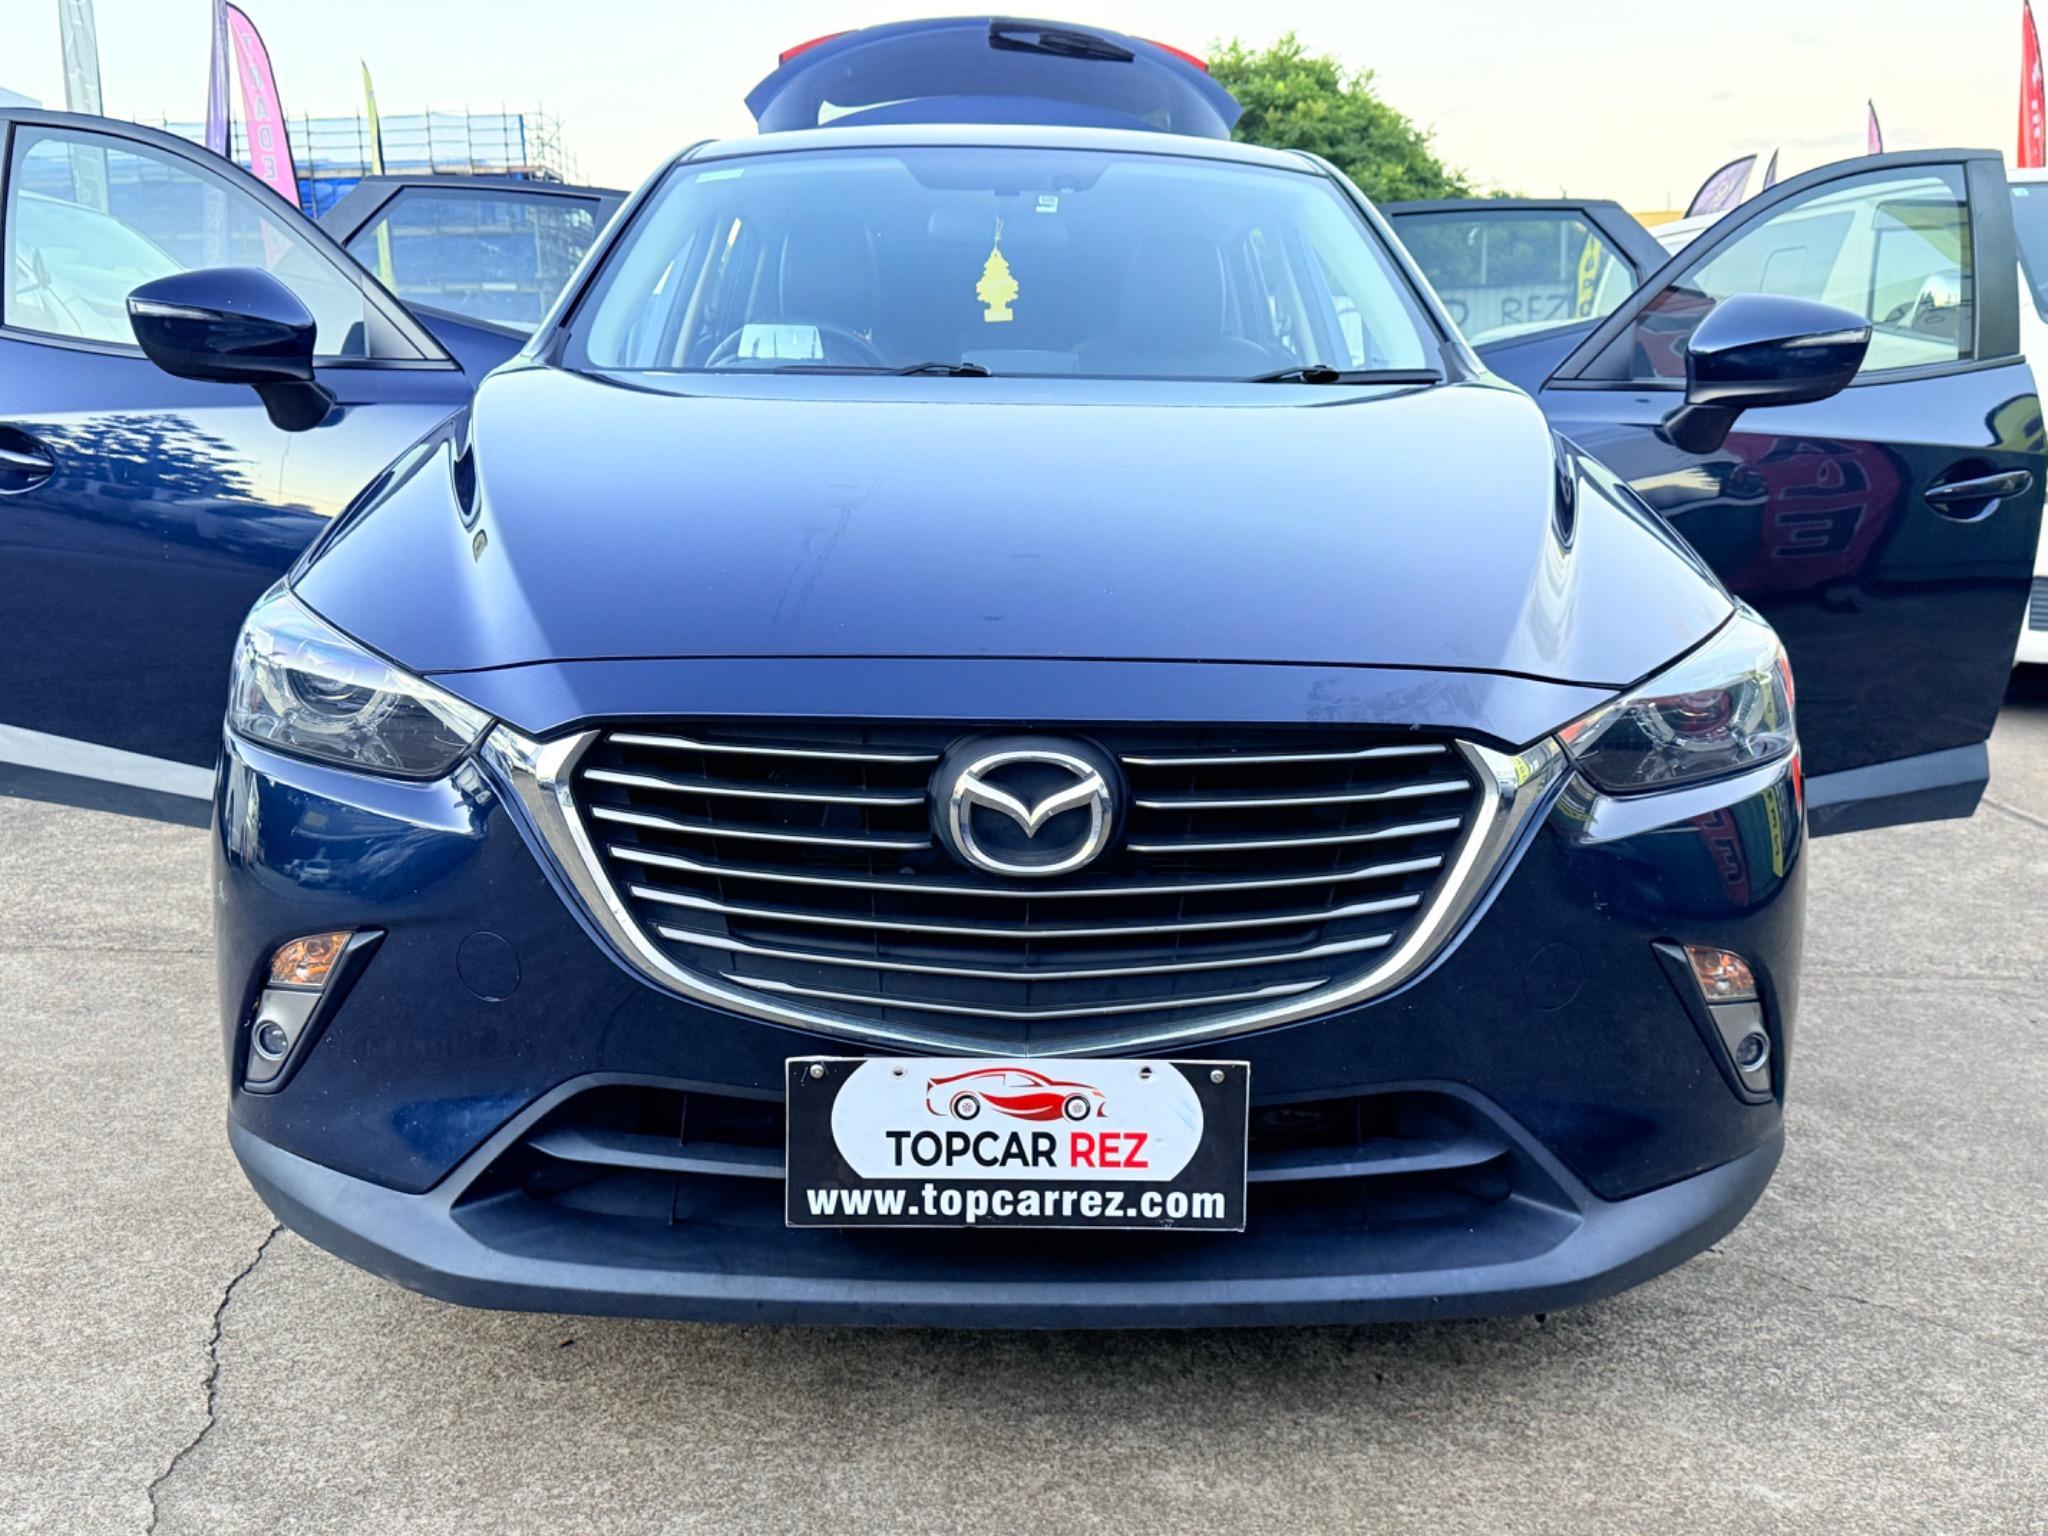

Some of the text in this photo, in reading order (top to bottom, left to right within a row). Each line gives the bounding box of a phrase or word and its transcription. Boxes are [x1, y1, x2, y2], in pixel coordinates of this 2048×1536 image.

[886, 1130, 1149, 1168] TOPCAR REZ
[806, 1183, 1226, 1223] www.topcarrez.com
